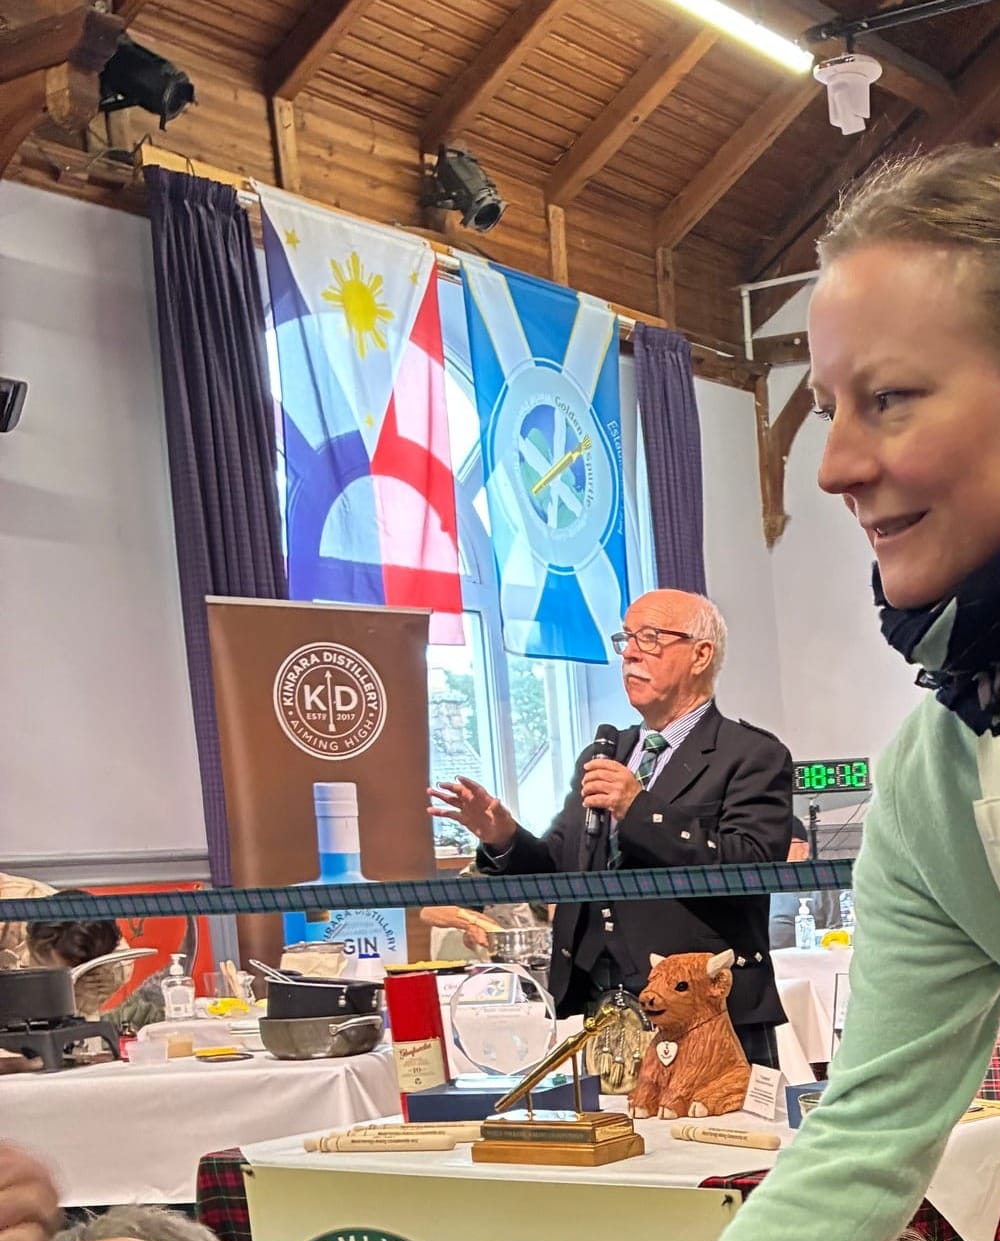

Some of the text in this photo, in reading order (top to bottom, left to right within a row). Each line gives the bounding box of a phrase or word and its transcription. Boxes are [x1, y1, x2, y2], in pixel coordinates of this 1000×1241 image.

[283, 653, 320, 706] KINRARA
[323, 651, 378, 710] DISTILLERY
[336, 713, 356, 721] 2017
[291, 720, 374, 751] AIMING HIGH
[343, 936, 379, 955] GIN
